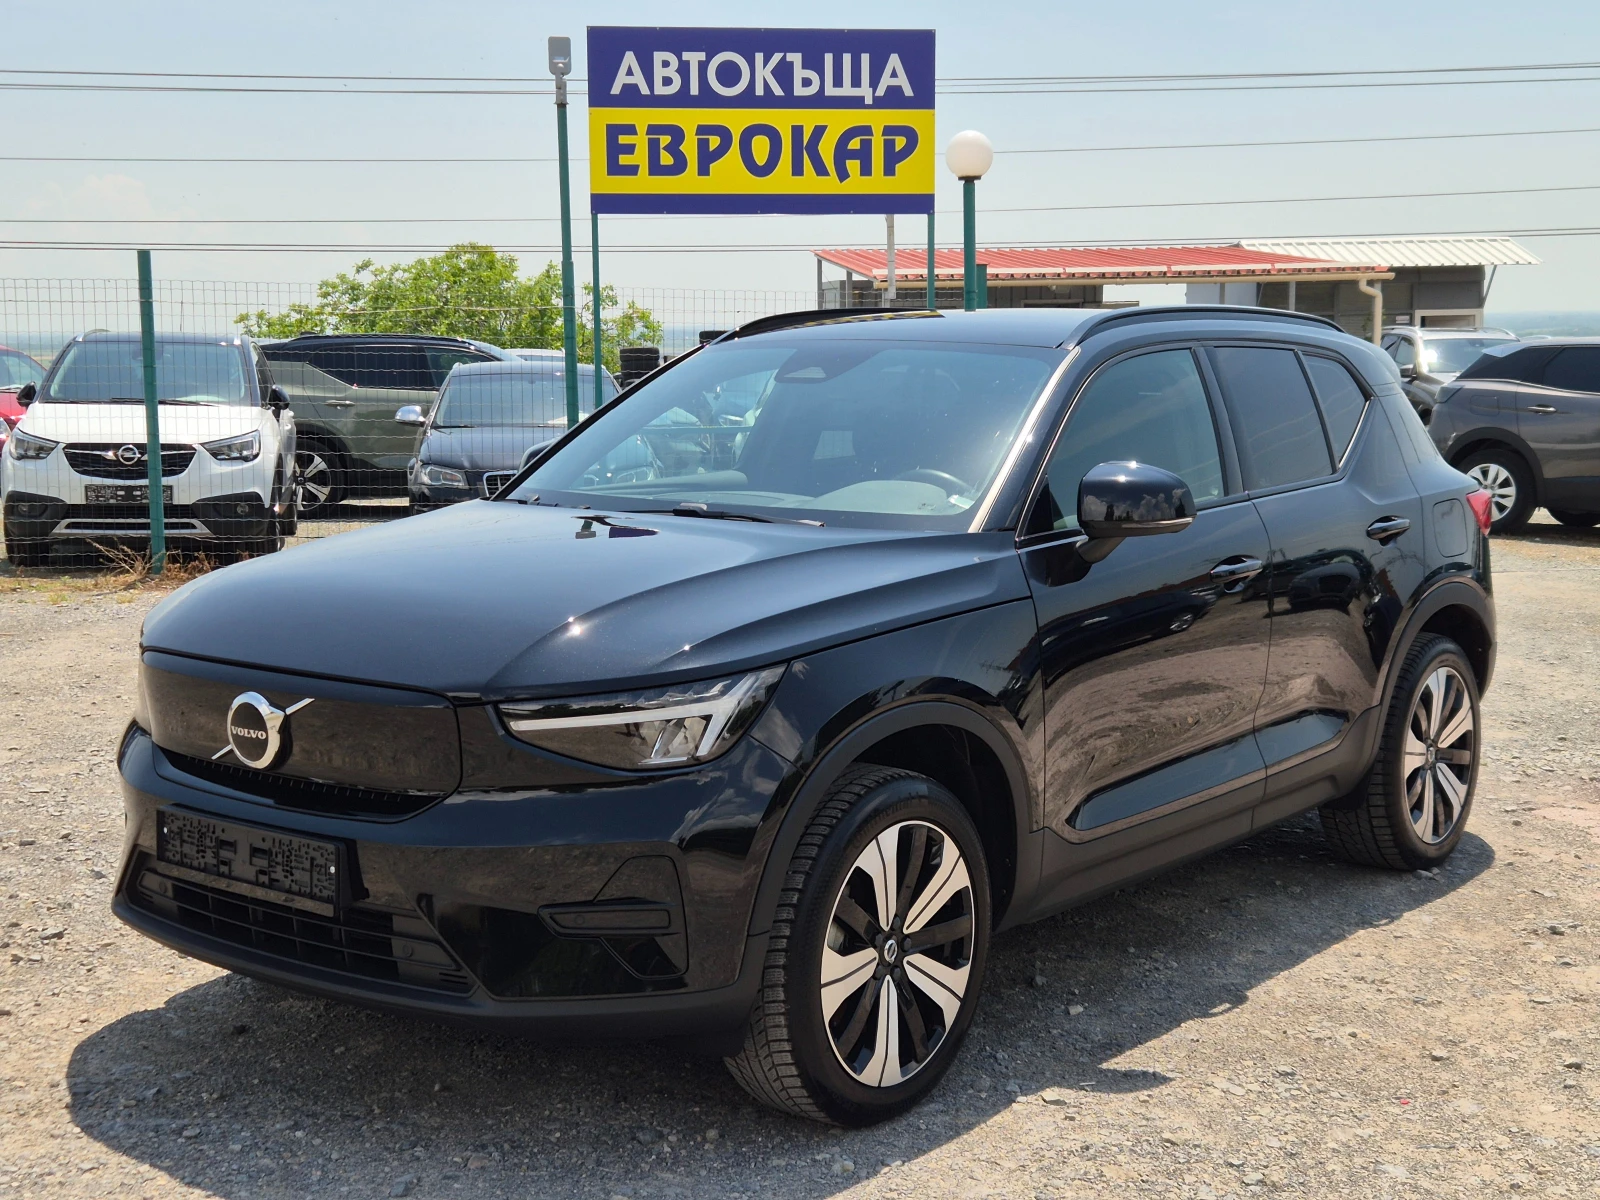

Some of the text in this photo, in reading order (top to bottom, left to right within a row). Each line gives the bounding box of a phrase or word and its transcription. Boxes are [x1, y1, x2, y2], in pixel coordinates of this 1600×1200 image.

[610, 51, 914, 104] АВТОКЪЩА
[605, 123, 919, 184] ЕВРОКАР
[231, 725, 267, 740] VOLVO
